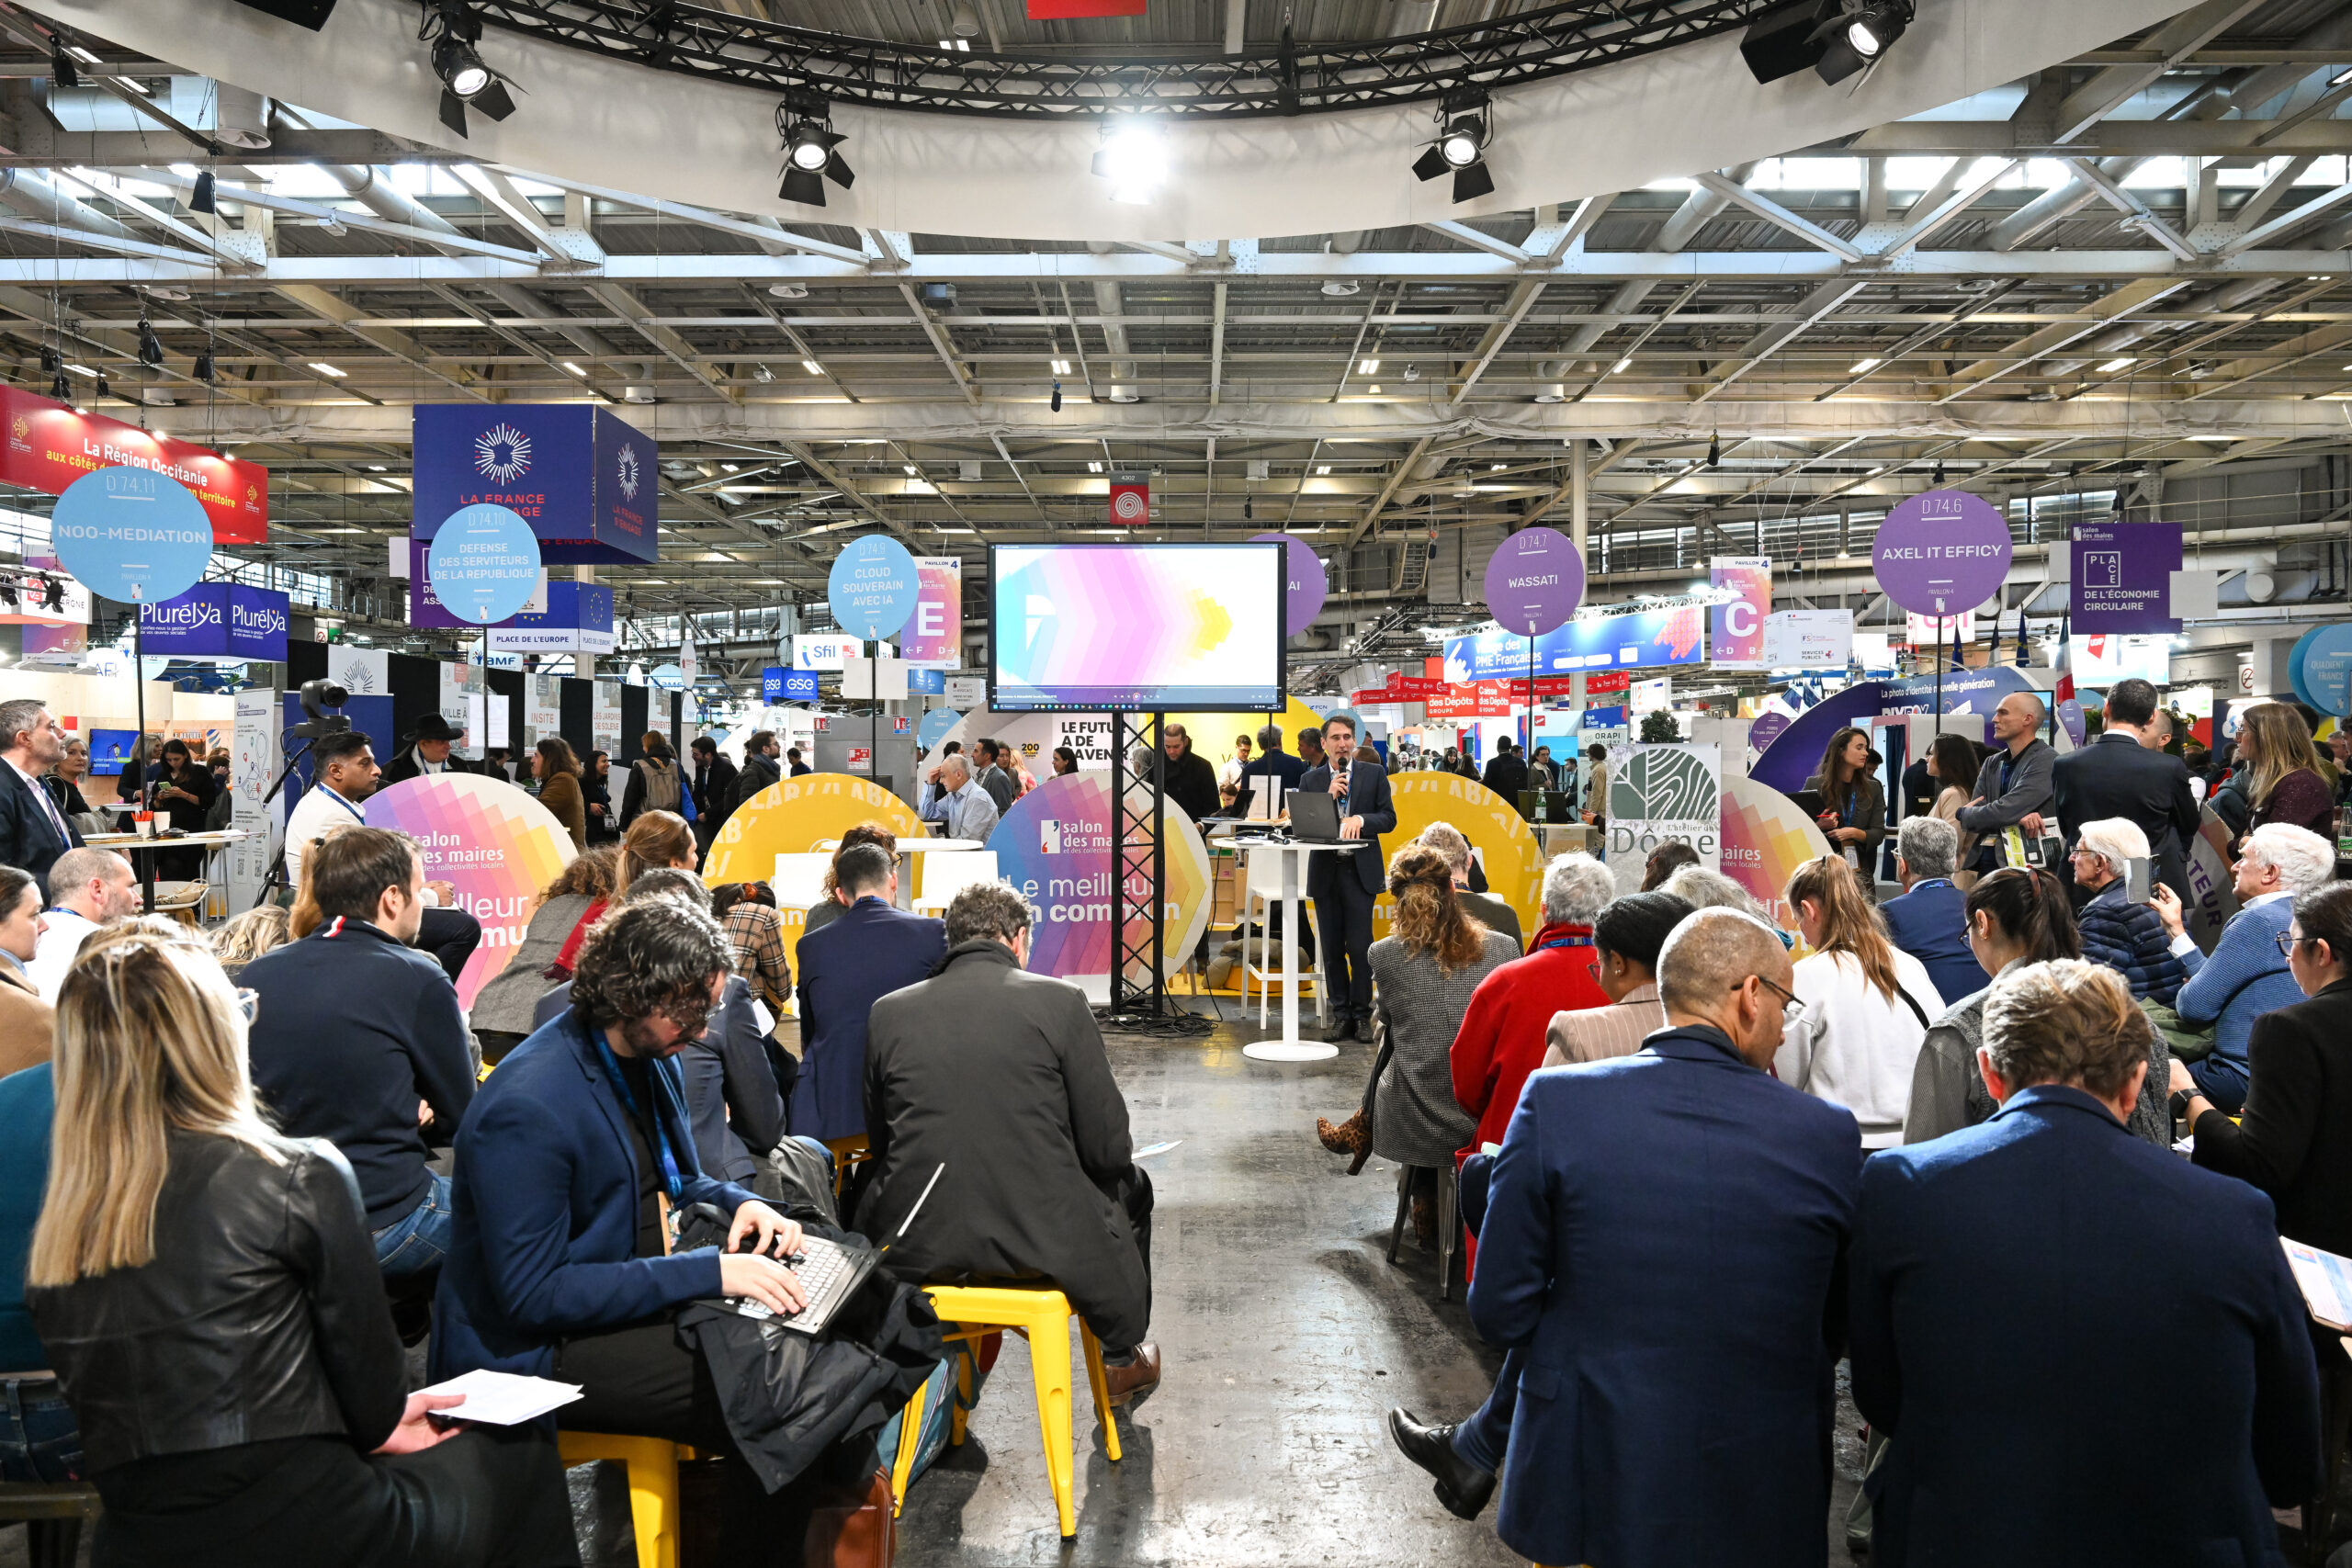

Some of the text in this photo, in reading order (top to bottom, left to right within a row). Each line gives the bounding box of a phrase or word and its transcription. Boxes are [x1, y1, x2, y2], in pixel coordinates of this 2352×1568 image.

[46, 449, 66, 464] aux
[69, 455, 96, 471] côtés
[84, 437, 208, 487] La Région Occitanie
[106, 475, 155, 493] D 74.11
[199, 489, 236, 508] territoire
[460, 494, 545, 504] LA FRANCE
[1922, 498, 1962, 513] D 74.6
[469, 513, 476, 526] D
[58, 525, 208, 545] NOO-MEDIATION
[1519, 534, 1547, 549] D 74.7
[459, 543, 508, 553] DEFENSE
[1882, 544, 2003, 559] AXEL IT EFFICY
[438, 555, 529, 567] DES SERVITEURS
[950, 560, 958, 569] 4
[1761, 559, 1769, 569] 4
[434, 568, 535, 580] DE LA REPUBLIQUE
[854, 567, 891, 579] CLOUD
[842, 581, 903, 593] SOUVERAIN
[1508, 574, 1558, 588] WASSATI
[2084, 589, 2160, 599] DE L'ÉCONOMIE
[853, 595, 894, 607] AVEC IA
[2084, 602, 2144, 611] CIRCULAIRE
[140, 602, 222, 629] Plurélya
[232, 604, 287, 635] Plurélya
[917, 601, 945, 637] E
[1724, 601, 1758, 637] C
[916, 646, 945, 654] F D
[1505, 638, 1521, 650] des
[813, 645, 836, 658] Sfil
[1476, 650, 1543, 667] PME Françaises
[2311, 660, 2346, 670] QUADIENT
[2318, 671, 2345, 680] FRANCE
[1478, 686, 1498, 694] Caisse
[1881, 678, 1996, 699] La photo d'identité nuvelle génération
[1429, 696, 1474, 707] des Dépôts
[1478, 696, 1510, 706] des Dépôts
[441, 706, 468, 718] VILLE À
[593, 712, 602, 720] LES
[531, 713, 554, 724] INSITE
[1061, 722, 1126, 733] LE FUTU
[1021, 743, 1040, 751] 200
[1061, 736, 1093, 747] A DE
[1076, 749, 1128, 761] AVENR
[1063, 819, 1102, 833] salon
[1668, 823, 1713, 832] L'atelier du
[413, 830, 460, 847] salon
[1063, 833, 1139, 848] des maes
[424, 846, 504, 863] es maires
[1082, 846, 1113, 854] collectivit
[437, 863, 478, 871] collectivités
[481, 861, 504, 869] locales
[1738, 861, 1761, 869] locales
[458, 892, 529, 919] lleur
